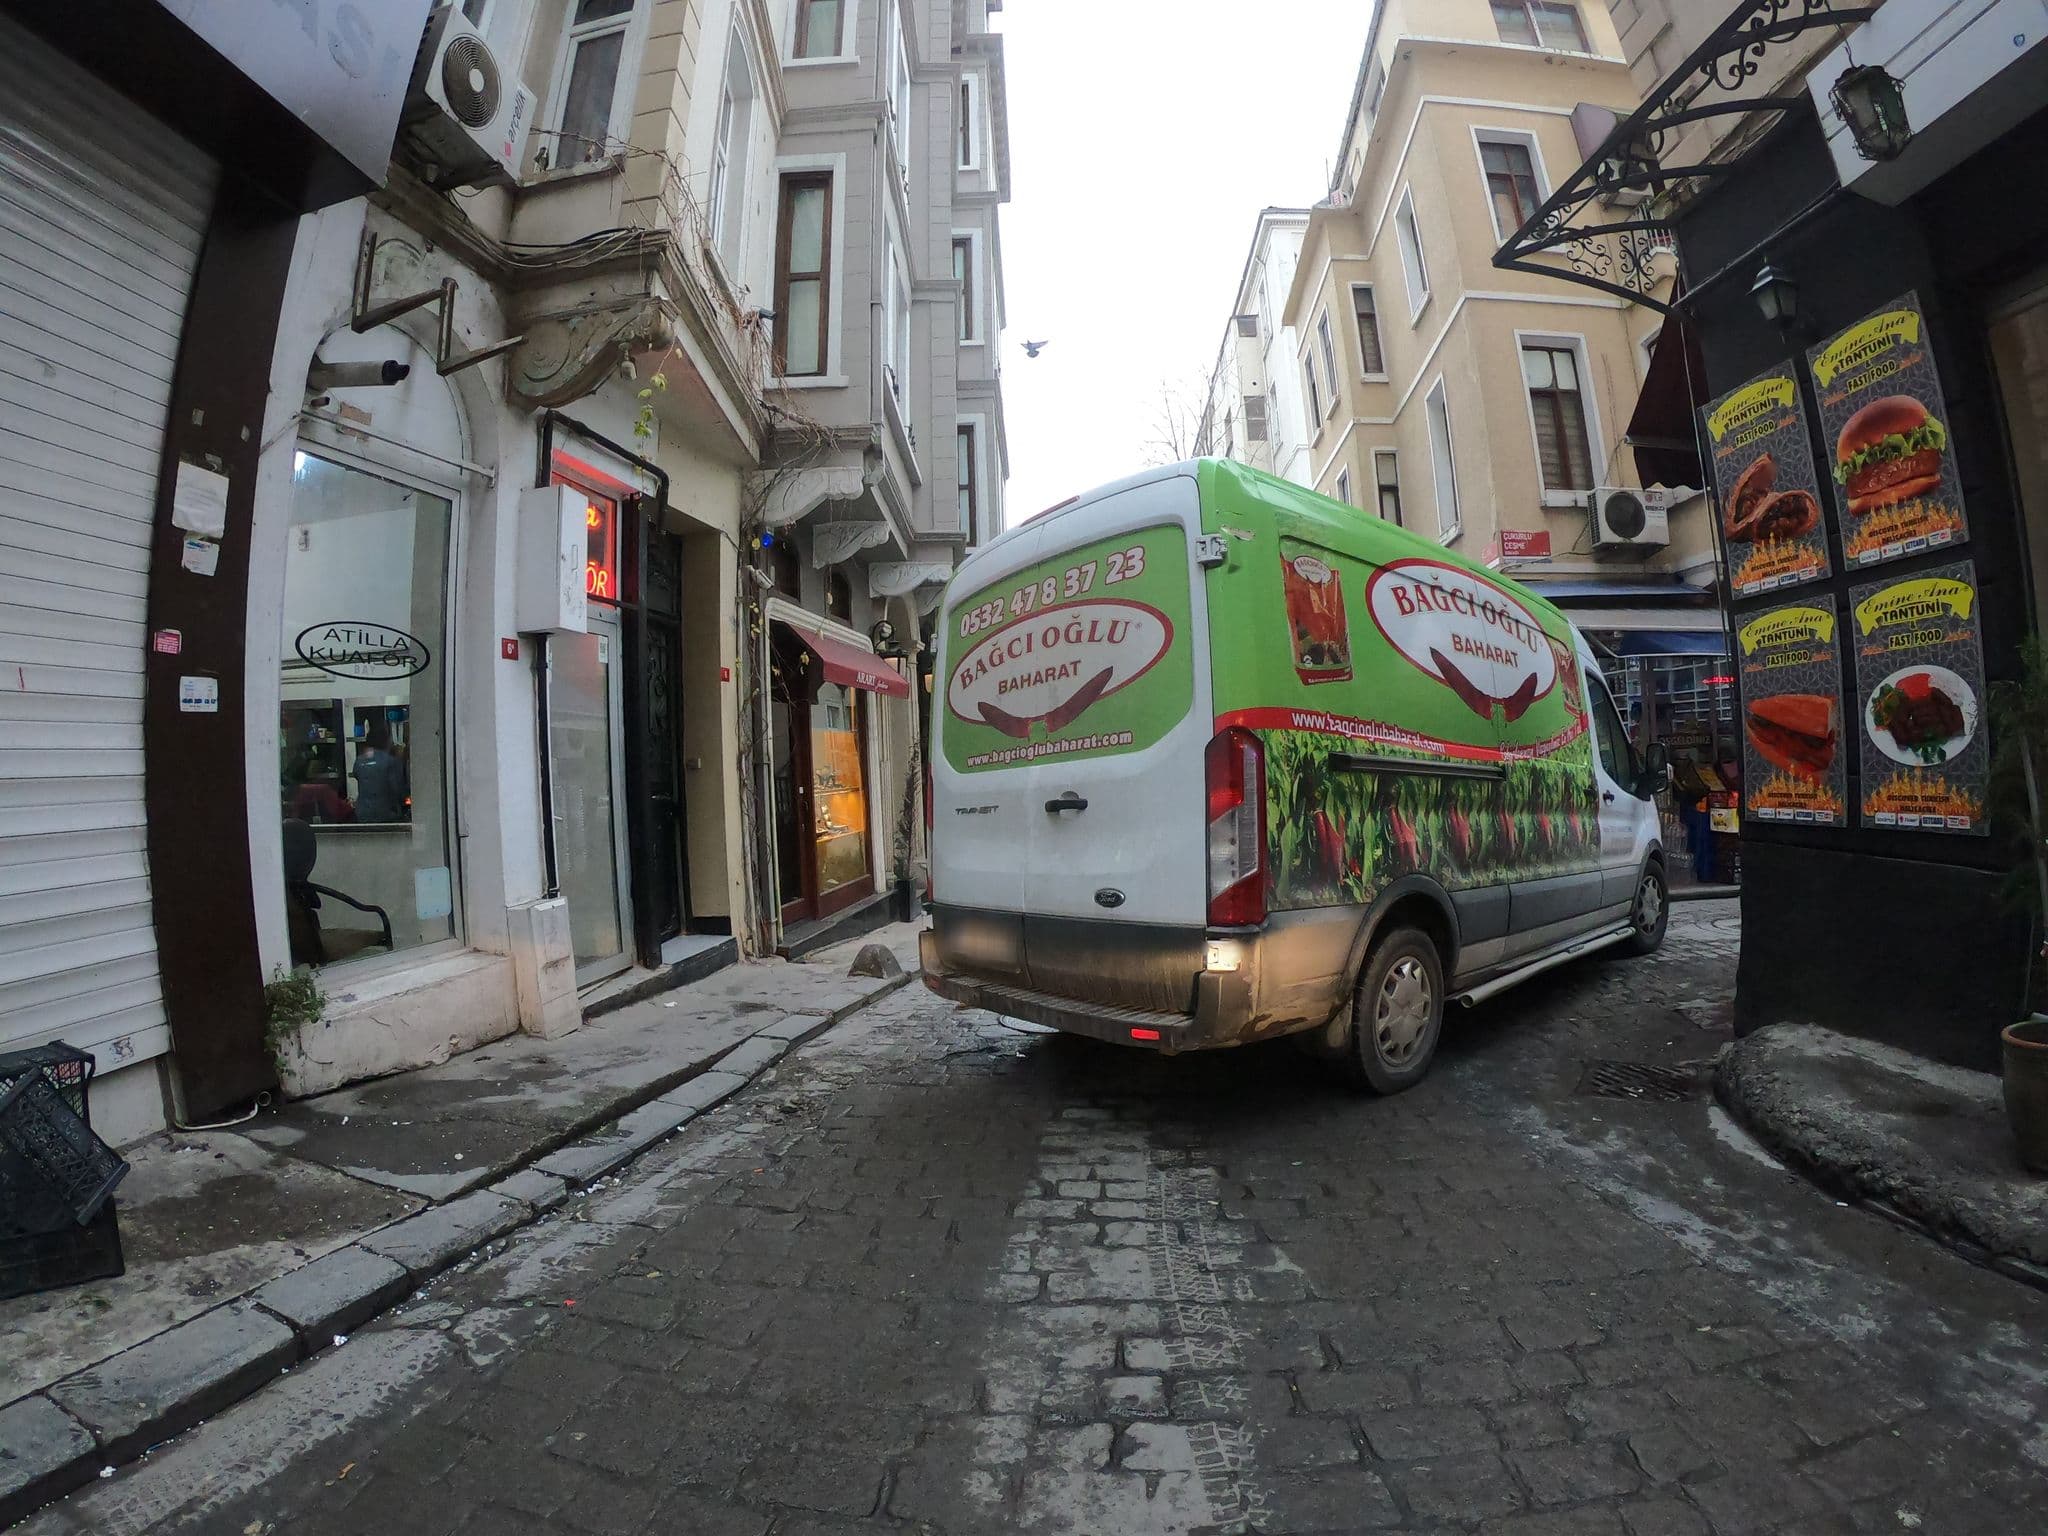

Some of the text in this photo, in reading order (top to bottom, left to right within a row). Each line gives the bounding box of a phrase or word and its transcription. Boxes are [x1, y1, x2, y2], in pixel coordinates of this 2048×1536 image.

[508, 90, 526, 143] arçelik
[1820, 315, 1905, 367] Emine Ana
[1848, 360, 1895, 391] FAST FOOD
[1735, 421, 1774, 445] FAST FOOD
[960, 598, 1005, 639] 0532
[1064, 560, 1097, 598] 37
[1105, 545, 1145, 585] 23
[1863, 582, 1959, 614] Emine Ana
[324, 628, 409, 650] ATİLLA
[1746, 611, 1823, 637] Emine Ana
[1890, 630, 1941, 647] FAST FOOD
[1451, 633, 1519, 668] BAHARAT
[1767, 651, 1809, 666] FAST FOOD
[998, 660, 1082, 695] BAHARAT
[1292, 710, 1446, 753] www.bagcioglubaharat.com
[967, 731, 1133, 767] www.bagcioglubaharat.com
